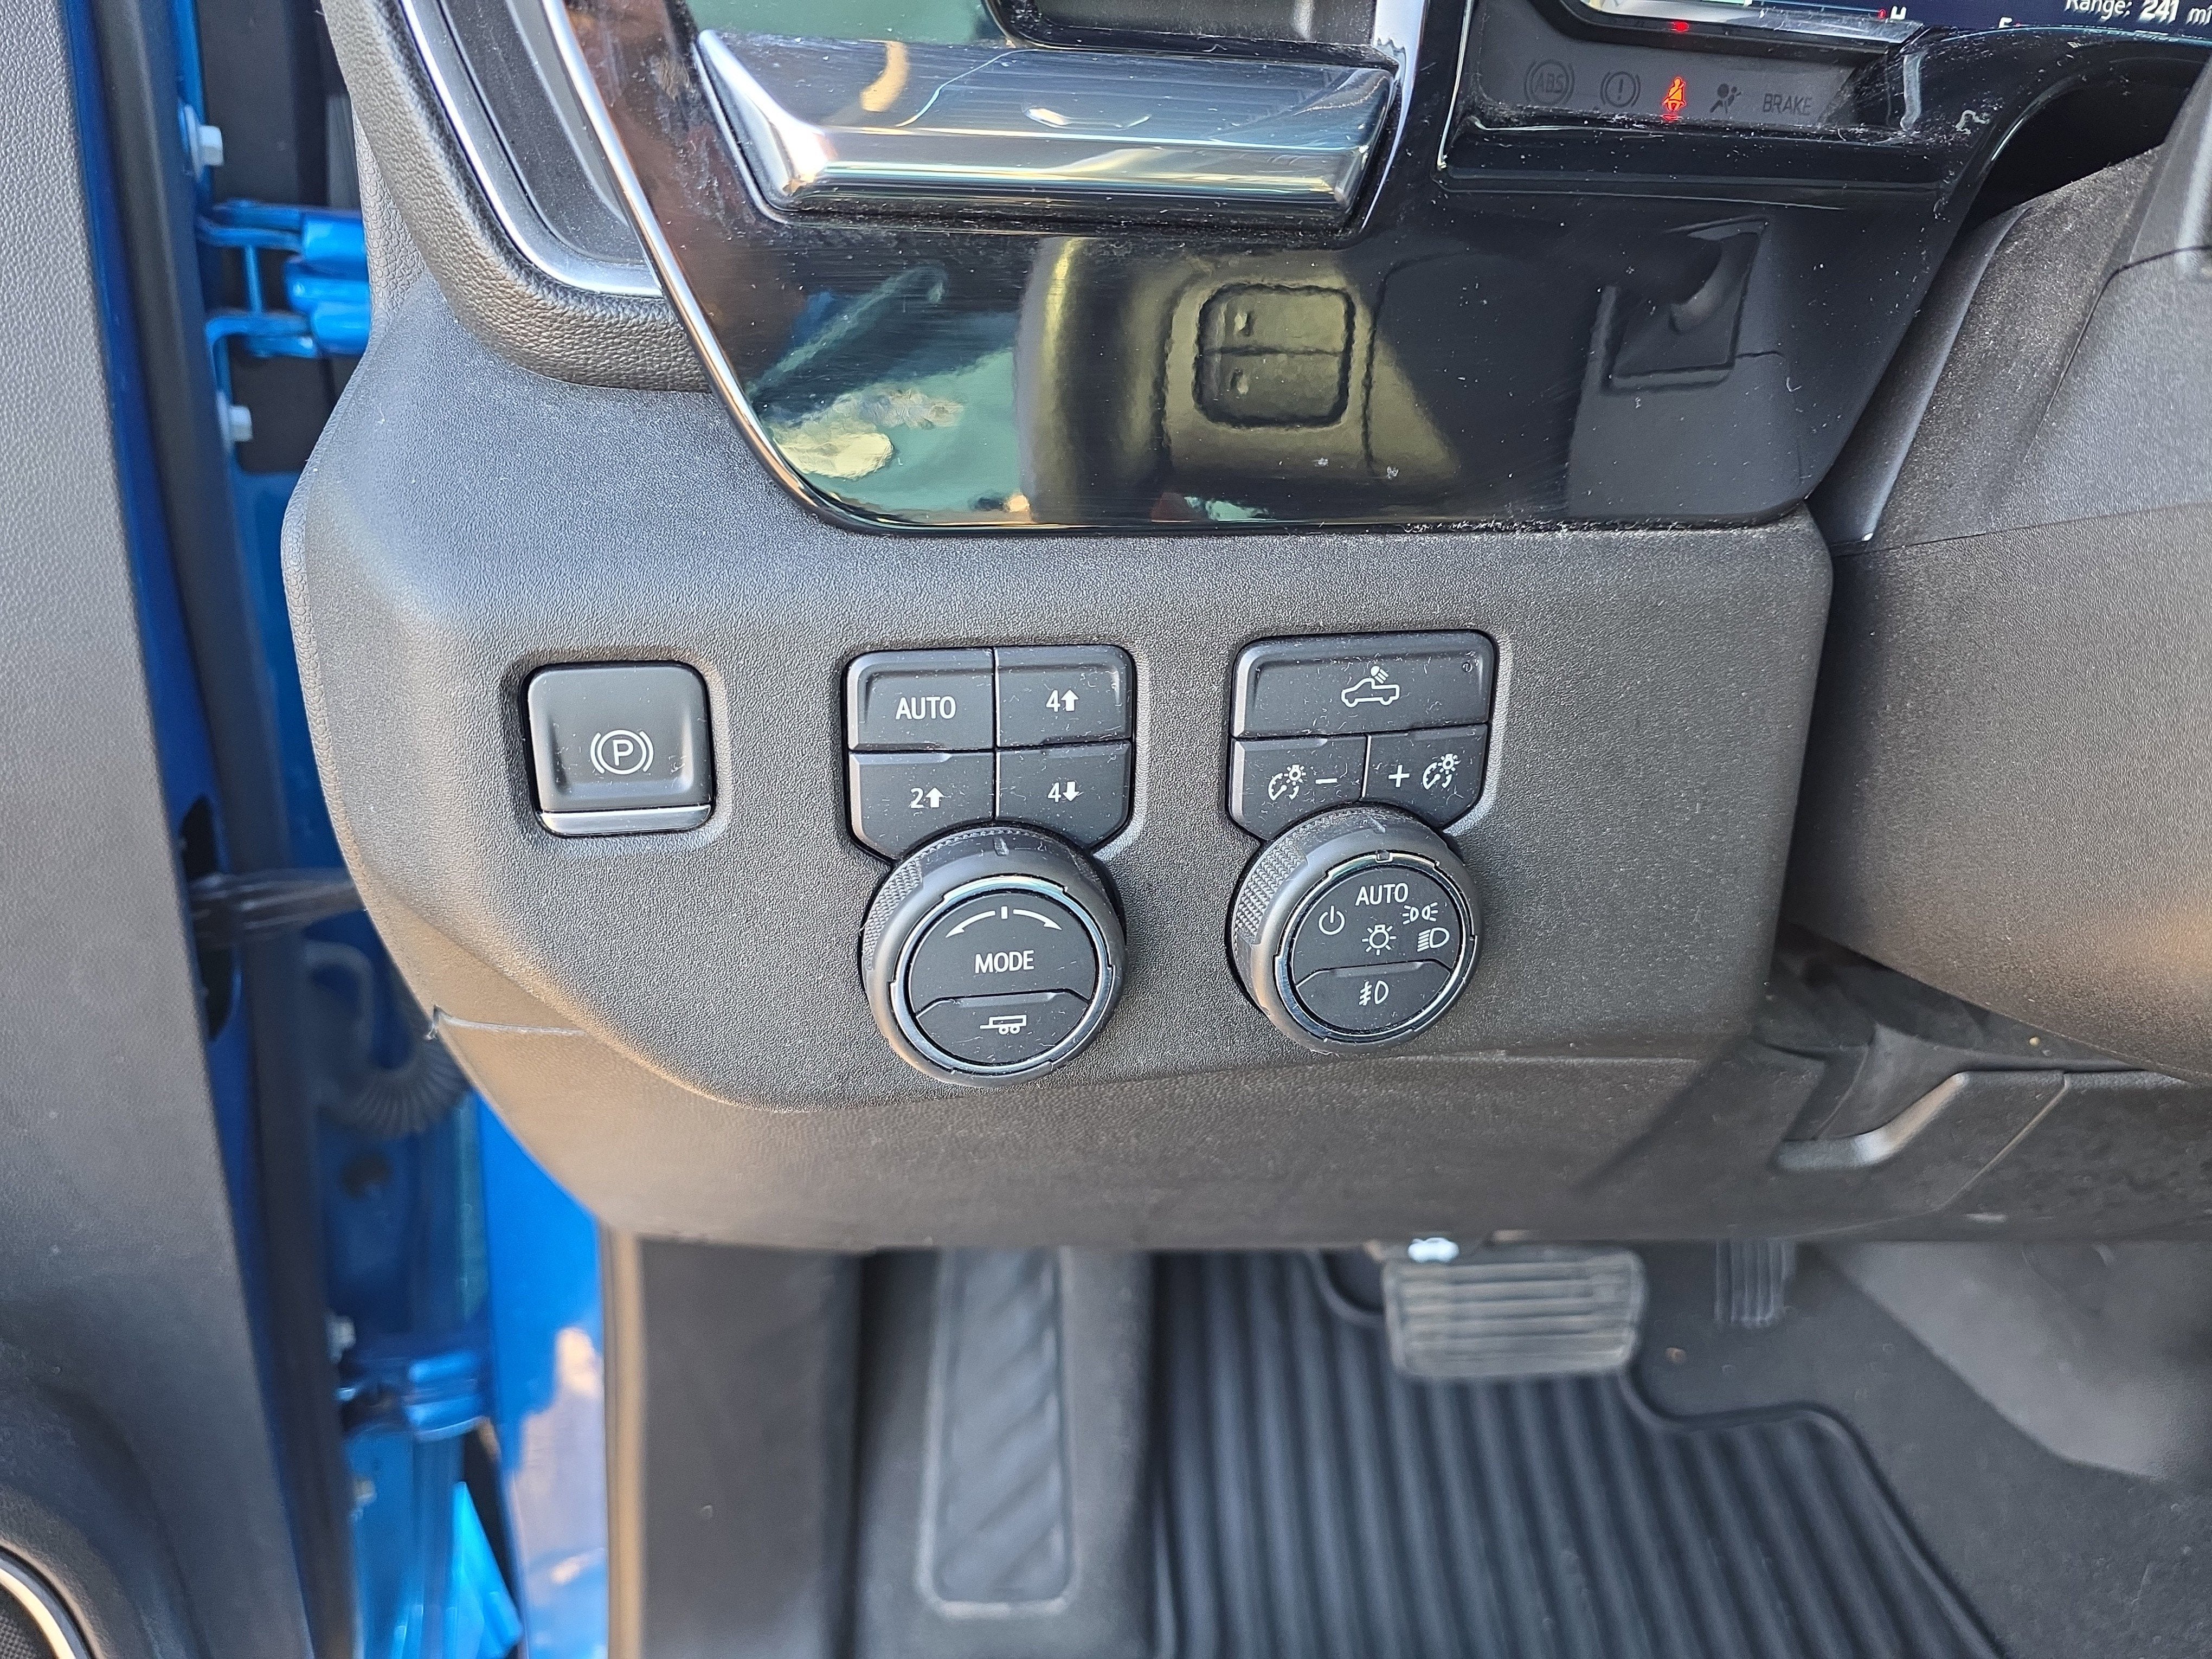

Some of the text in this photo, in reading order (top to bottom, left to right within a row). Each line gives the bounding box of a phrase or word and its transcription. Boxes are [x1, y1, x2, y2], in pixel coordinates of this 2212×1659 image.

[2139, 0, 2179, 23] 241
[1535, 73, 1564, 94] ABS
[1763, 93, 1812, 115] BRAKE
[896, 696, 956, 720] AUTO
[613, 739, 634, 766] P
[1355, 883, 1409, 906] AUTO
[975, 949, 1035, 974] MODE
